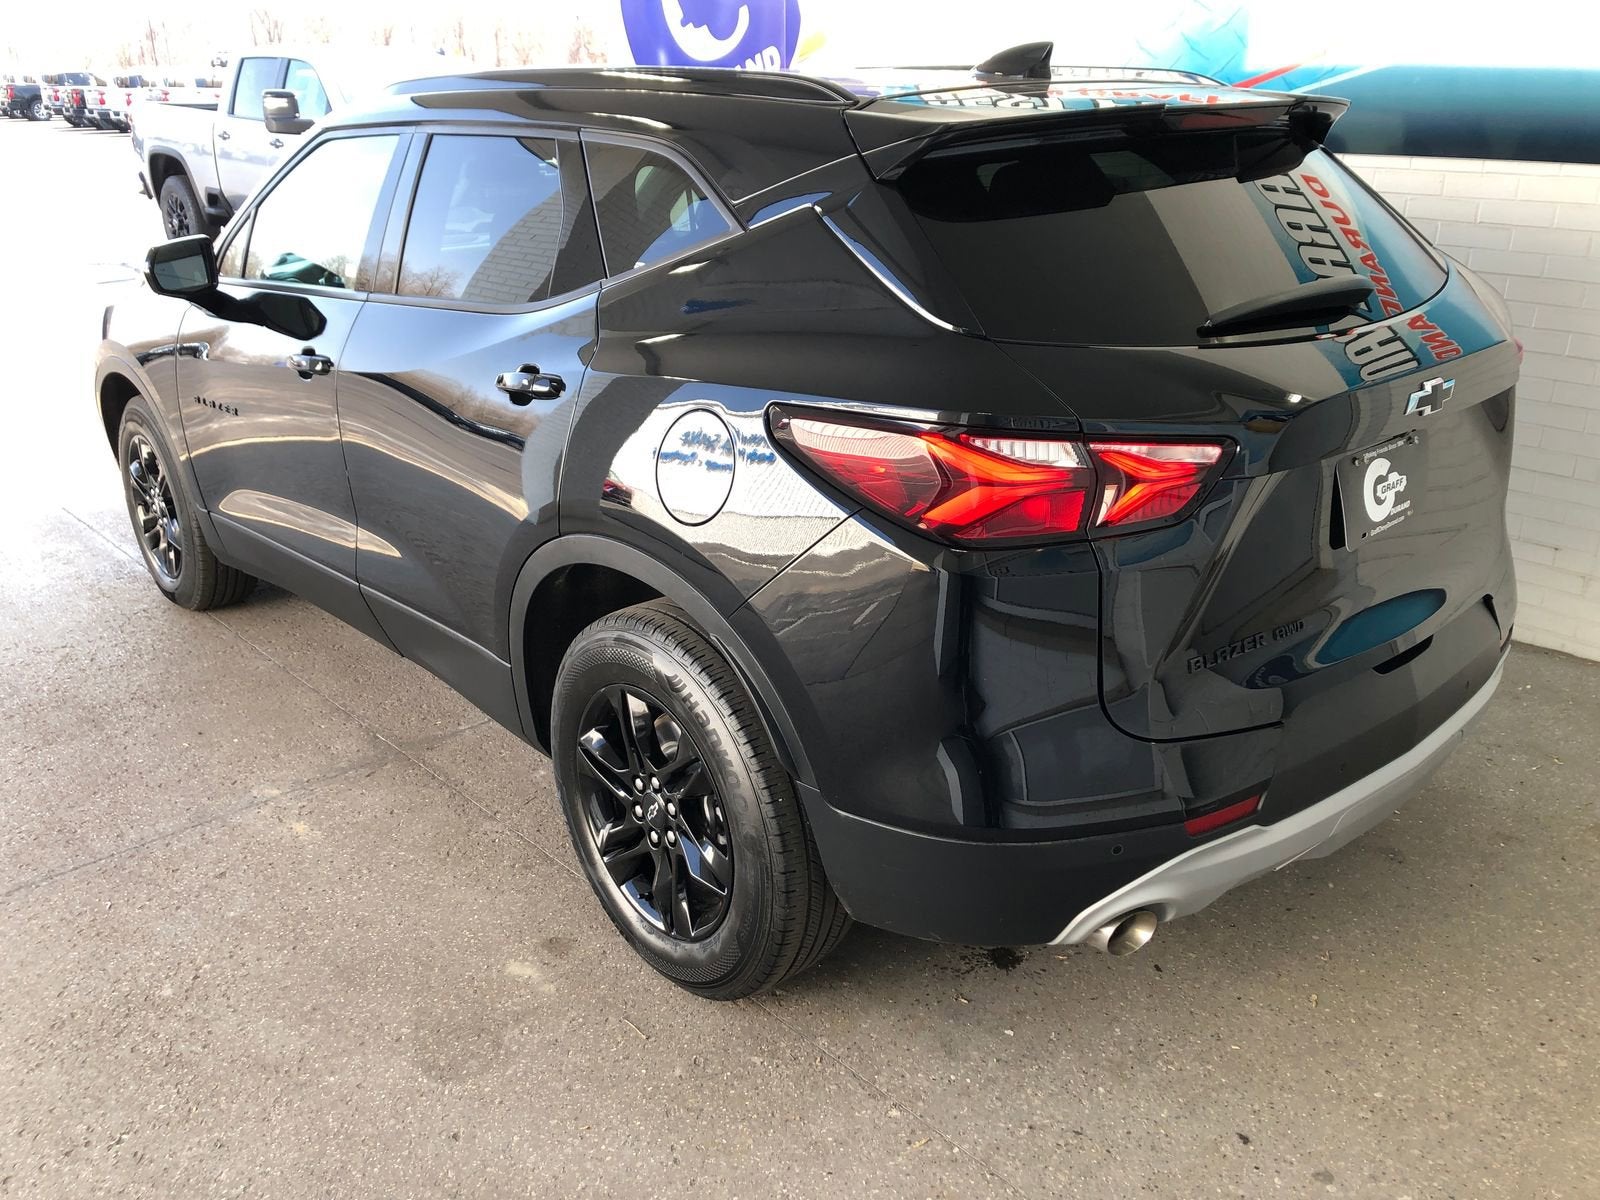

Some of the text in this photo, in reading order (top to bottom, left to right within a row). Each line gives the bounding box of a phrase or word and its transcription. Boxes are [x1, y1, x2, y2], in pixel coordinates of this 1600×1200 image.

[735, 45, 781, 71] ND
[1381, 478, 1404, 494] GRAFF
[1390, 500, 1411, 516] DURAND
[1272, 619, 1305, 641] AWD
[1187, 631, 1268, 675] BLAZER
